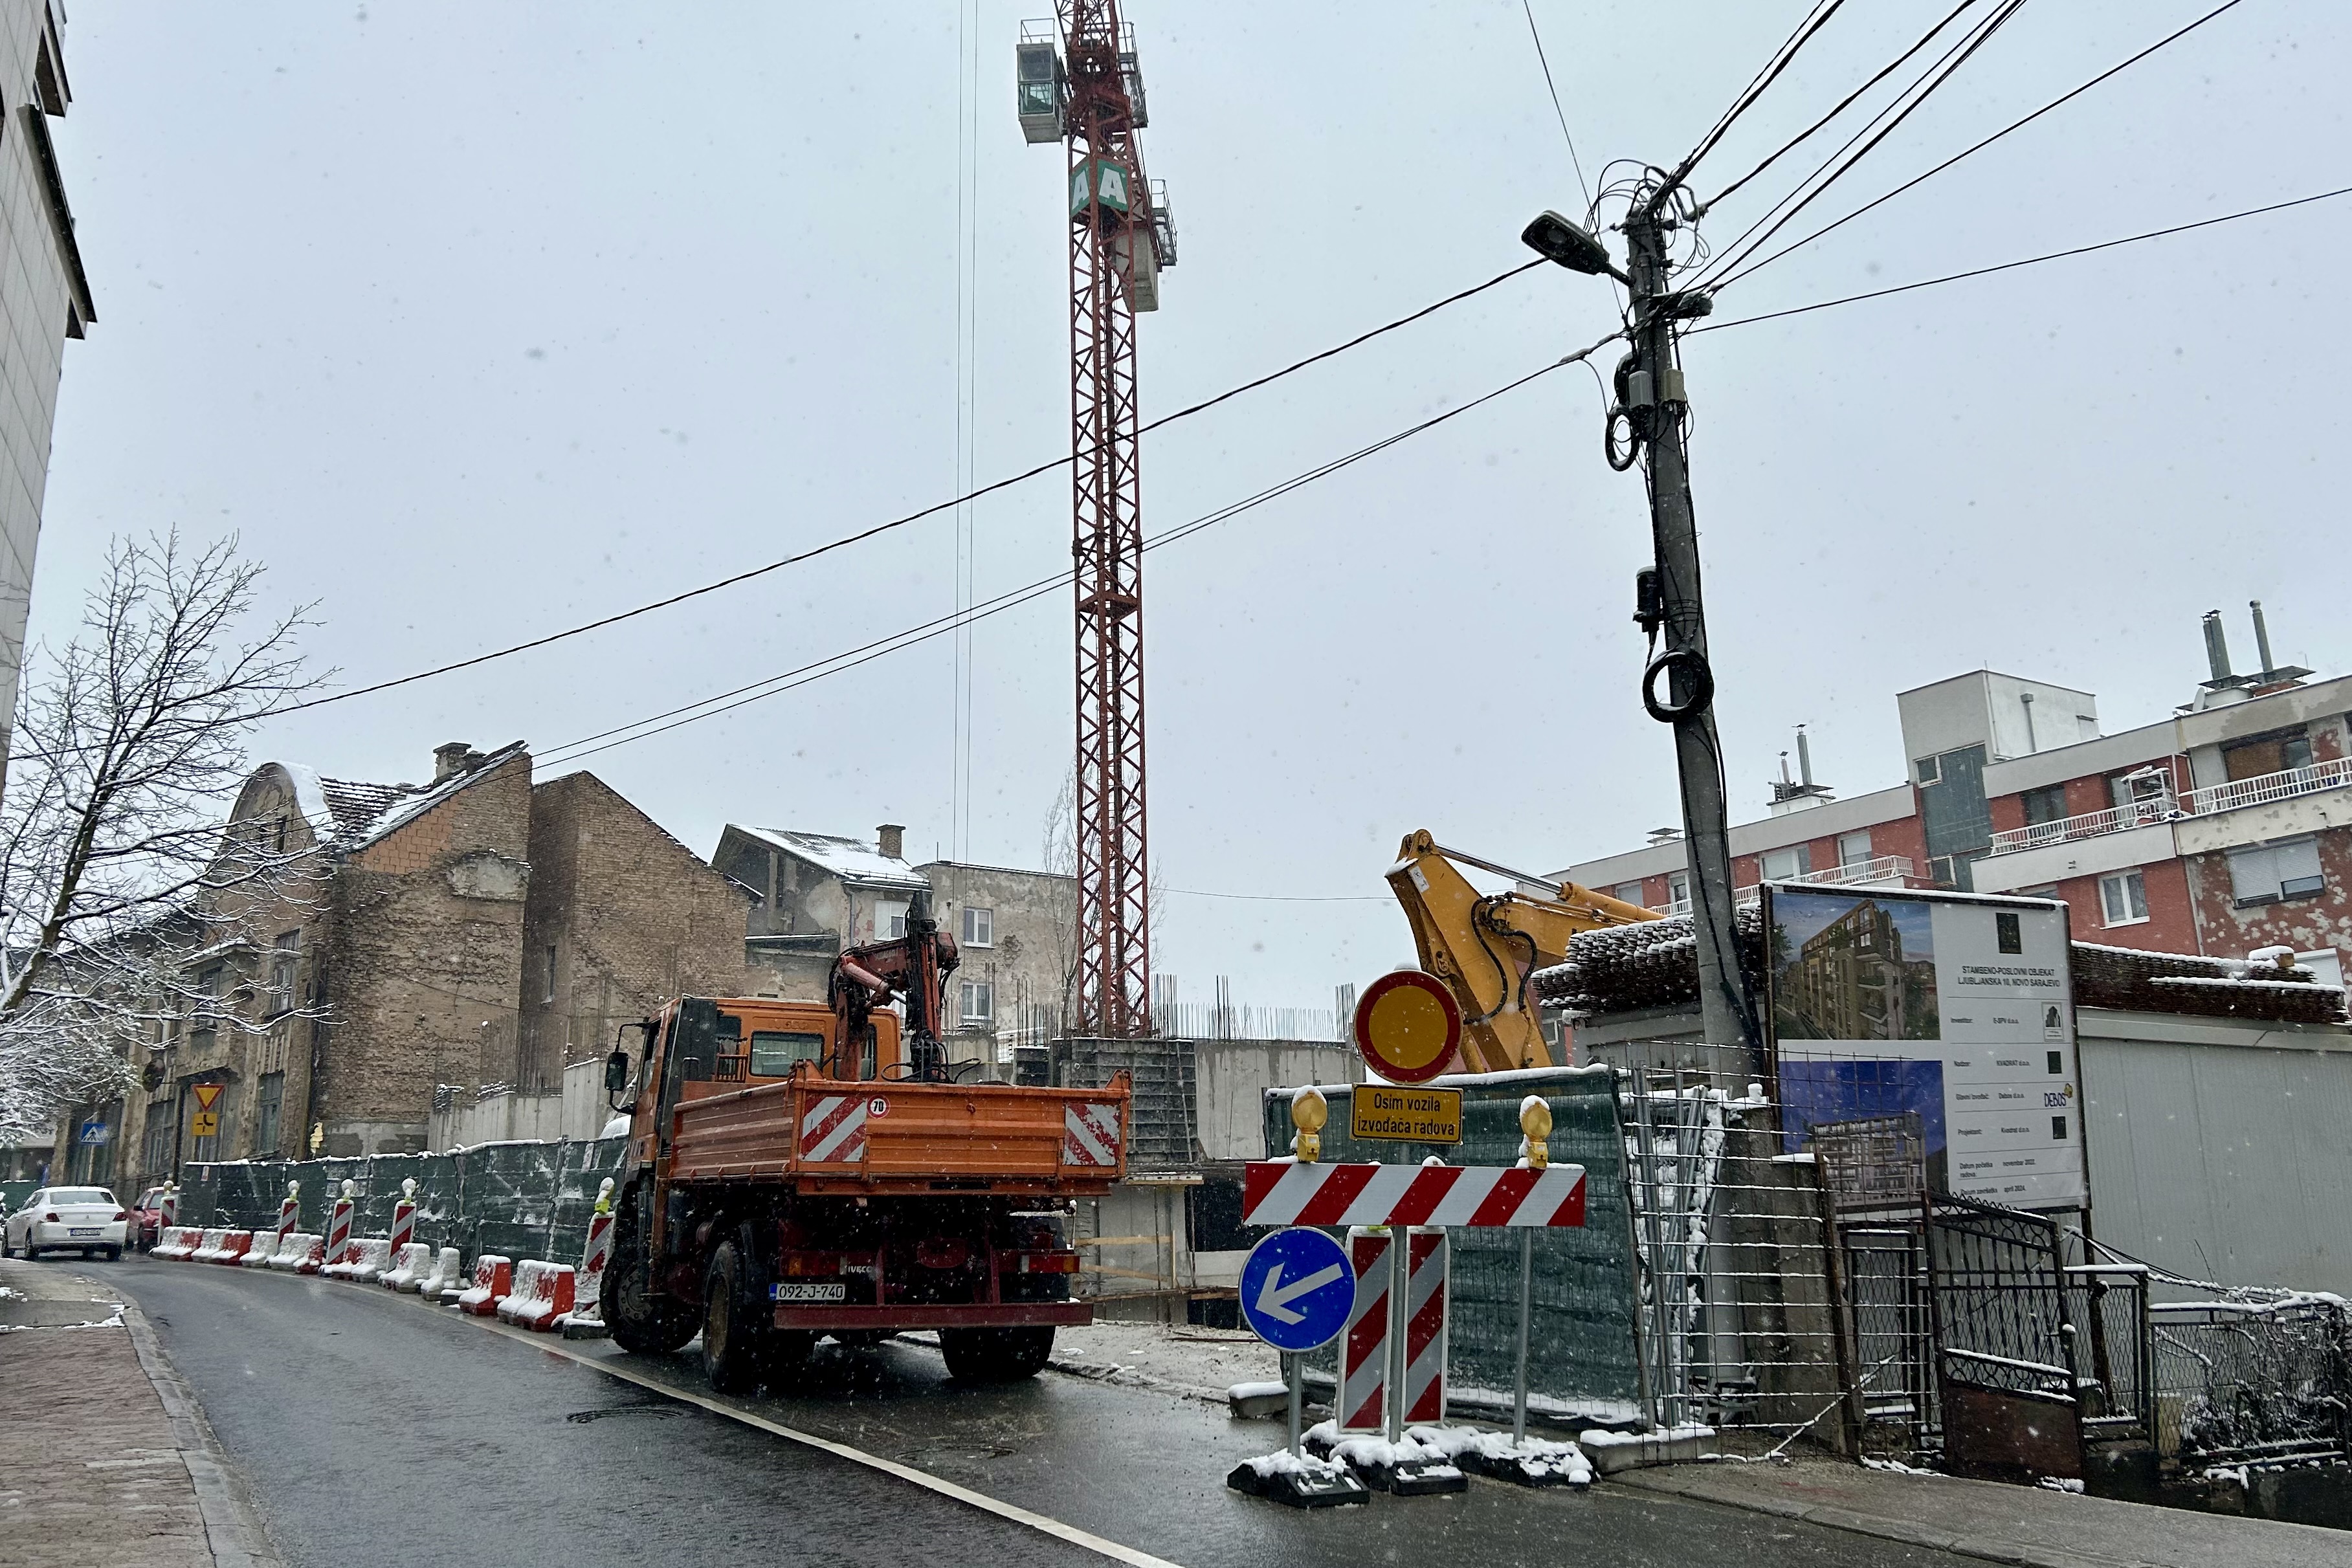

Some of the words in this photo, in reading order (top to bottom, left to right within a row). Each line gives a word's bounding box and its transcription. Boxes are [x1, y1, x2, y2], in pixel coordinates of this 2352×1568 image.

[1072, 170, 1090, 210] A
[1098, 168, 1127, 204] A
[2028, 968, 2056, 977] OBJEKAT
[1958, 977, 2002, 985] LJUBLJANSKA
[2012, 978, 2029, 987] NOVO
[874, 1101, 884, 1112] 70
[1374, 1092, 1403, 1110] Osim
[1407, 1096, 1441, 1112] vozila
[2044, 1092, 2067, 1107] DEBOS
[1414, 1118, 1454, 1136] radova
[848, 1265, 872, 1274] IVECO
[779, 1285, 843, 1299] 092-J-740
